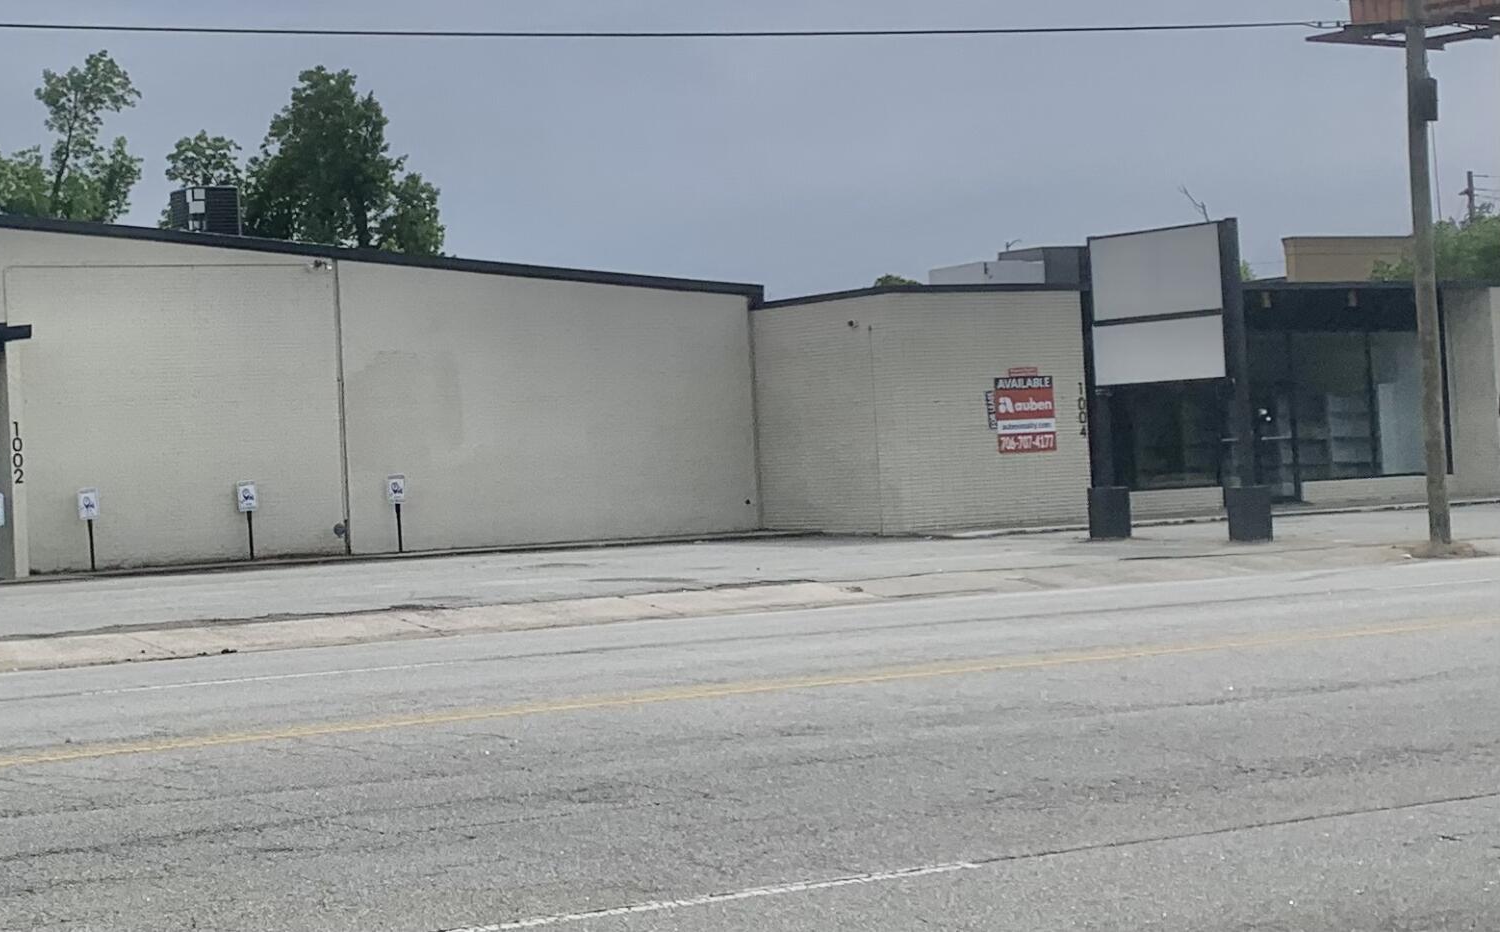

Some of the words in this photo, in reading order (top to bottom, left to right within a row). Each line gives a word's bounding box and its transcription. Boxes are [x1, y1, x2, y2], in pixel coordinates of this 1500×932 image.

[997, 377, 1050, 388] AVAILABLE
[1014, 397, 1052, 411] auben
[1077, 382, 1087, 437] 1004
[12, 421, 24, 485] 1002
